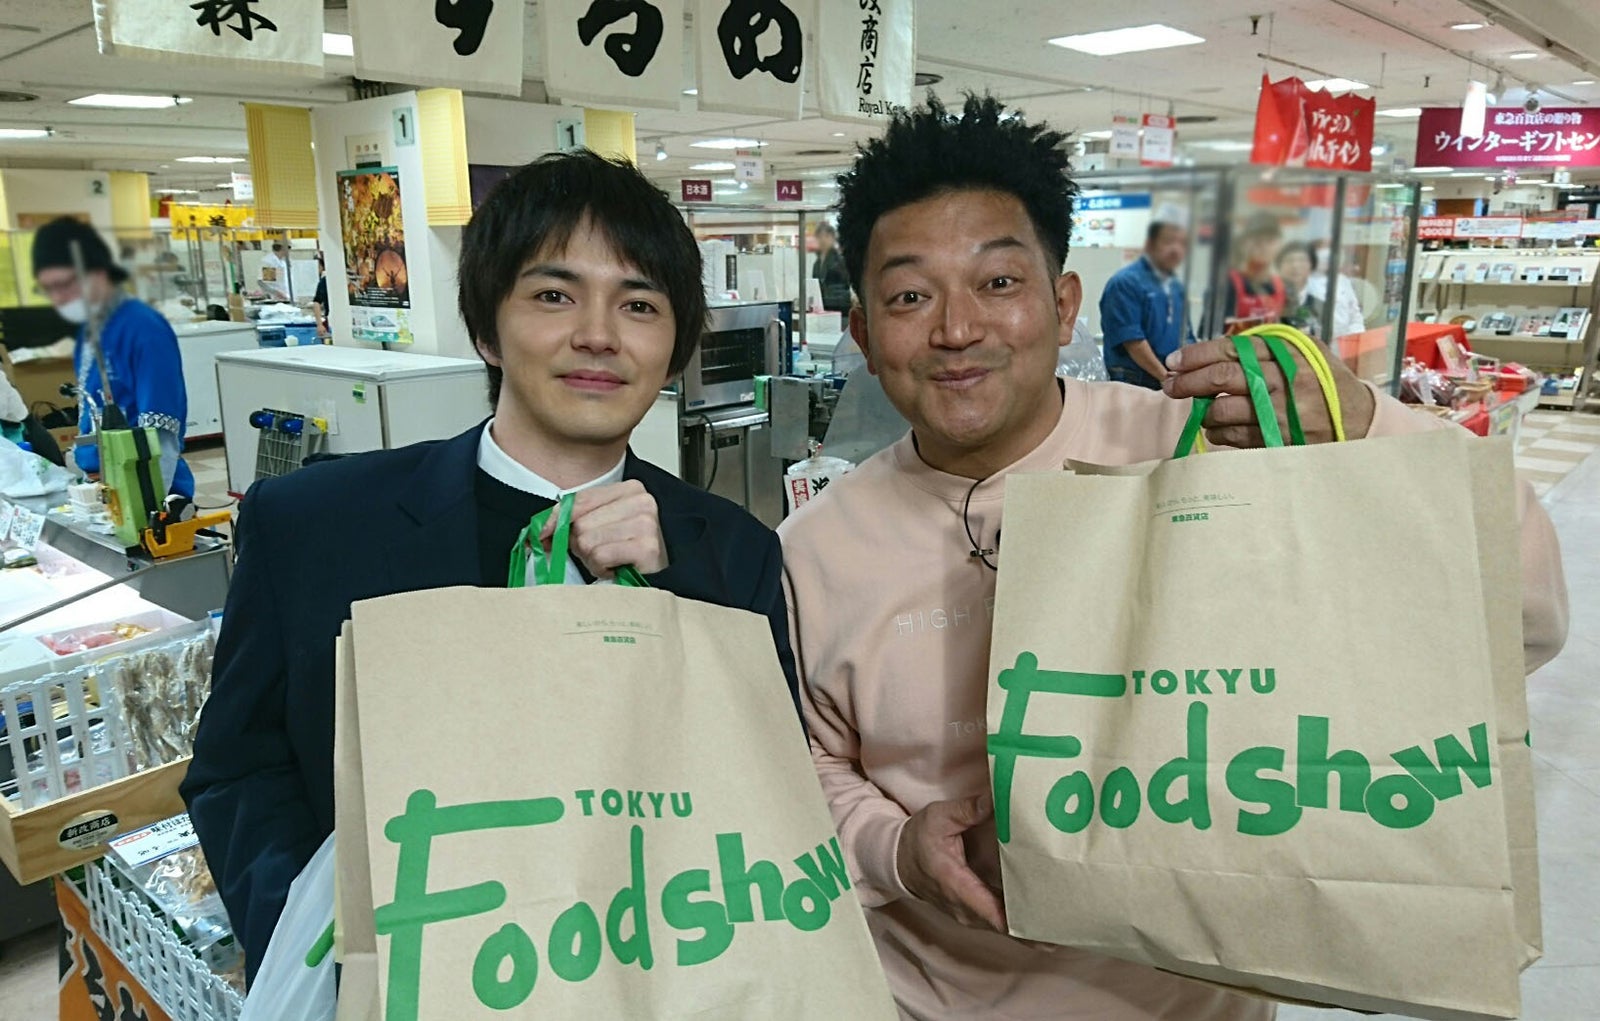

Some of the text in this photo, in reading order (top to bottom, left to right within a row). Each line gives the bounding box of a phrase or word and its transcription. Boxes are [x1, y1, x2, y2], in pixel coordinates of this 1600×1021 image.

[858, 98, 883, 117] Royal
[398, 113, 406, 138] 1
[565, 124, 575, 147] 1
[92, 180, 104, 195] 2
[895, 606, 970, 635] HIGH
[1133, 669, 1274, 694] TOKYU
[576, 790, 691, 817] TOKYU
